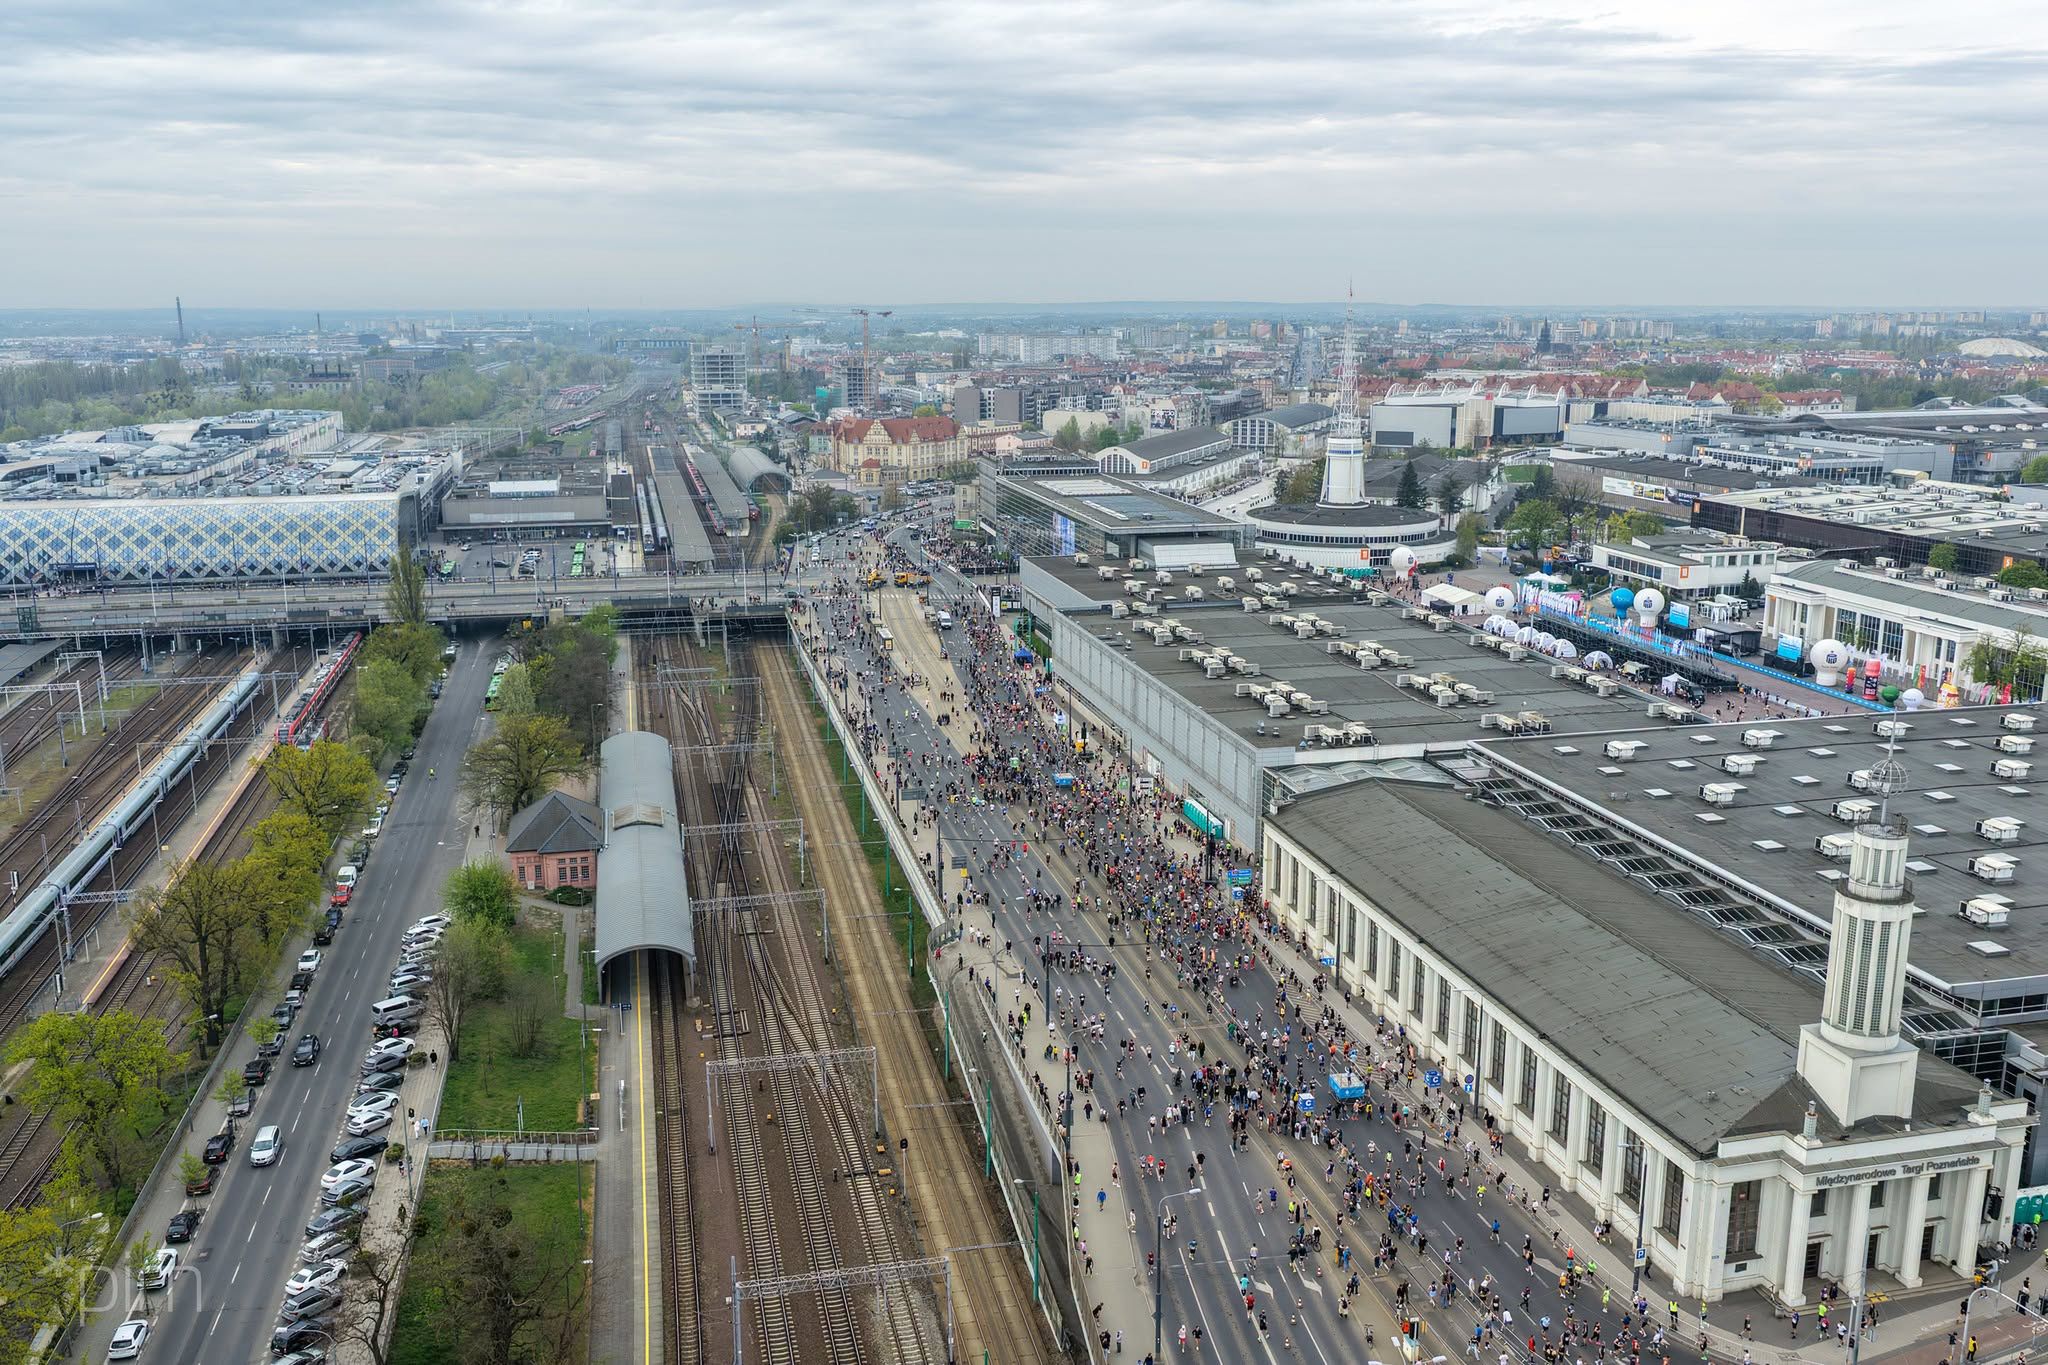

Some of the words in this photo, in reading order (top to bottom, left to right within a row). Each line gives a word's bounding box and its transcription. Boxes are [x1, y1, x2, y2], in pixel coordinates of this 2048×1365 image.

[1816, 1168, 1896, 1186] Międzynarodowe
[1901, 1162, 1924, 1176] Targi
[1926, 1155, 1980, 1172] Poznańskie
